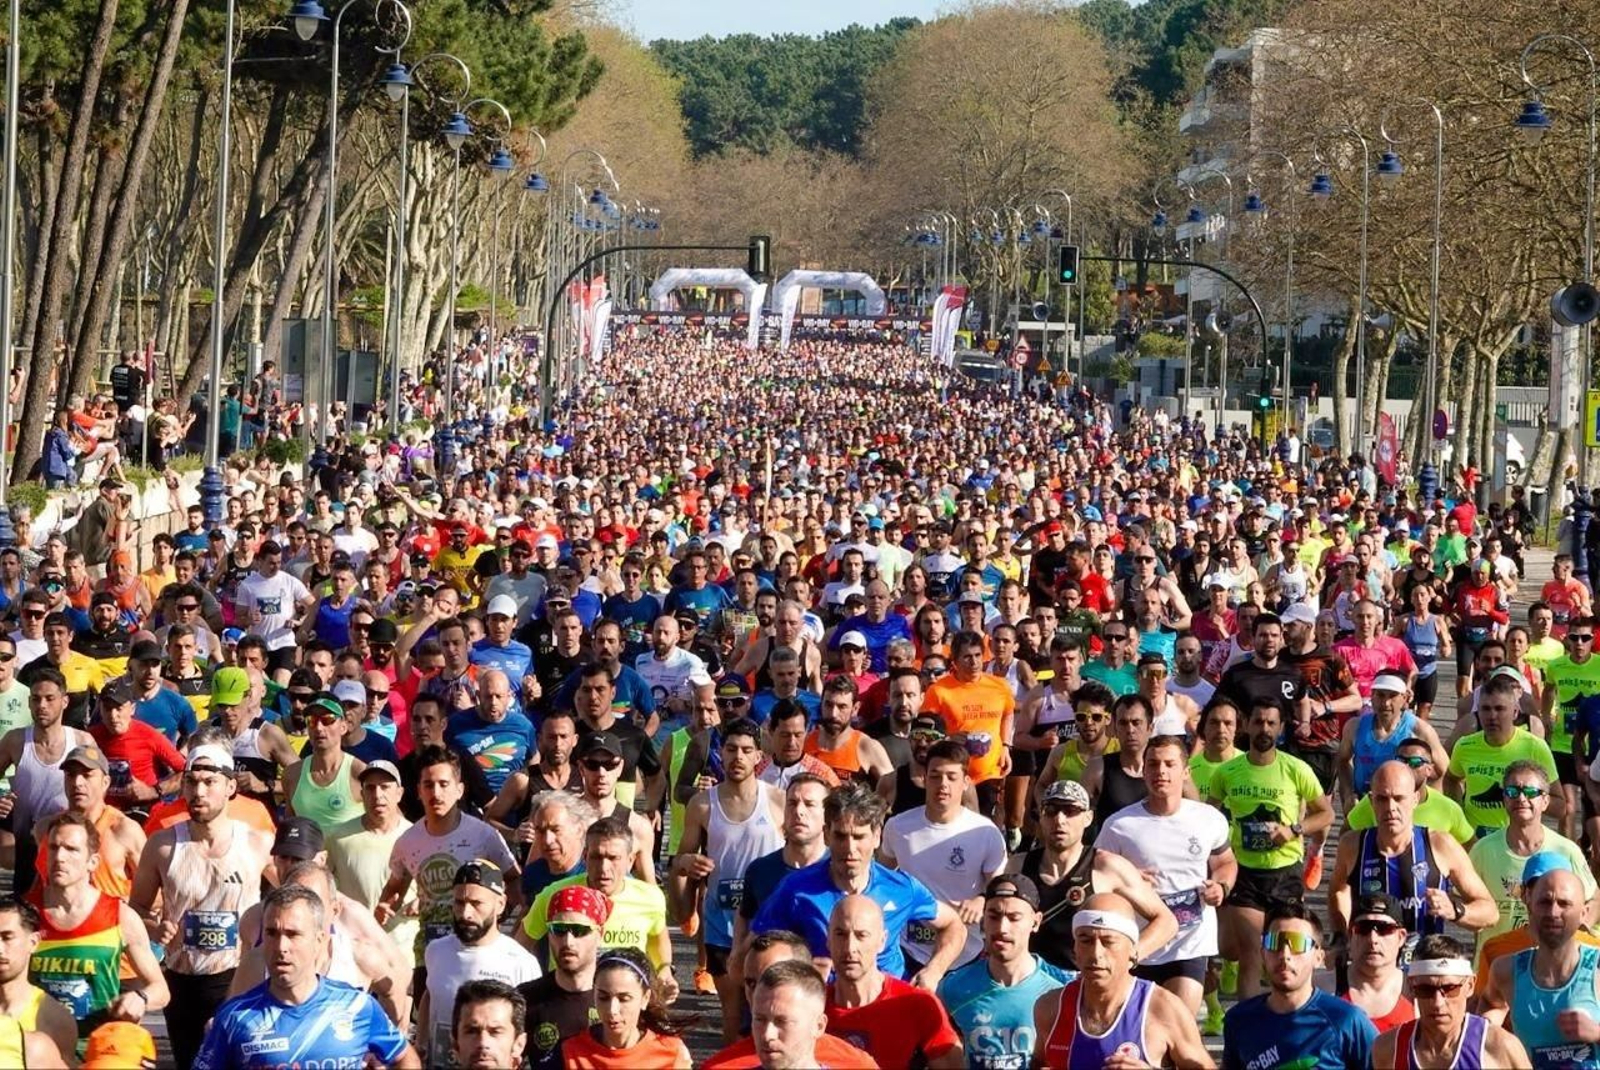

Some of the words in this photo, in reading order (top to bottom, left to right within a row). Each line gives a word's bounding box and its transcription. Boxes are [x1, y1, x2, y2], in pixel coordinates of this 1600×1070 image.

[199, 931, 228, 947] 298
[30, 957, 98, 976] BIKILA
[243, 1039, 285, 1054] DISMAC
